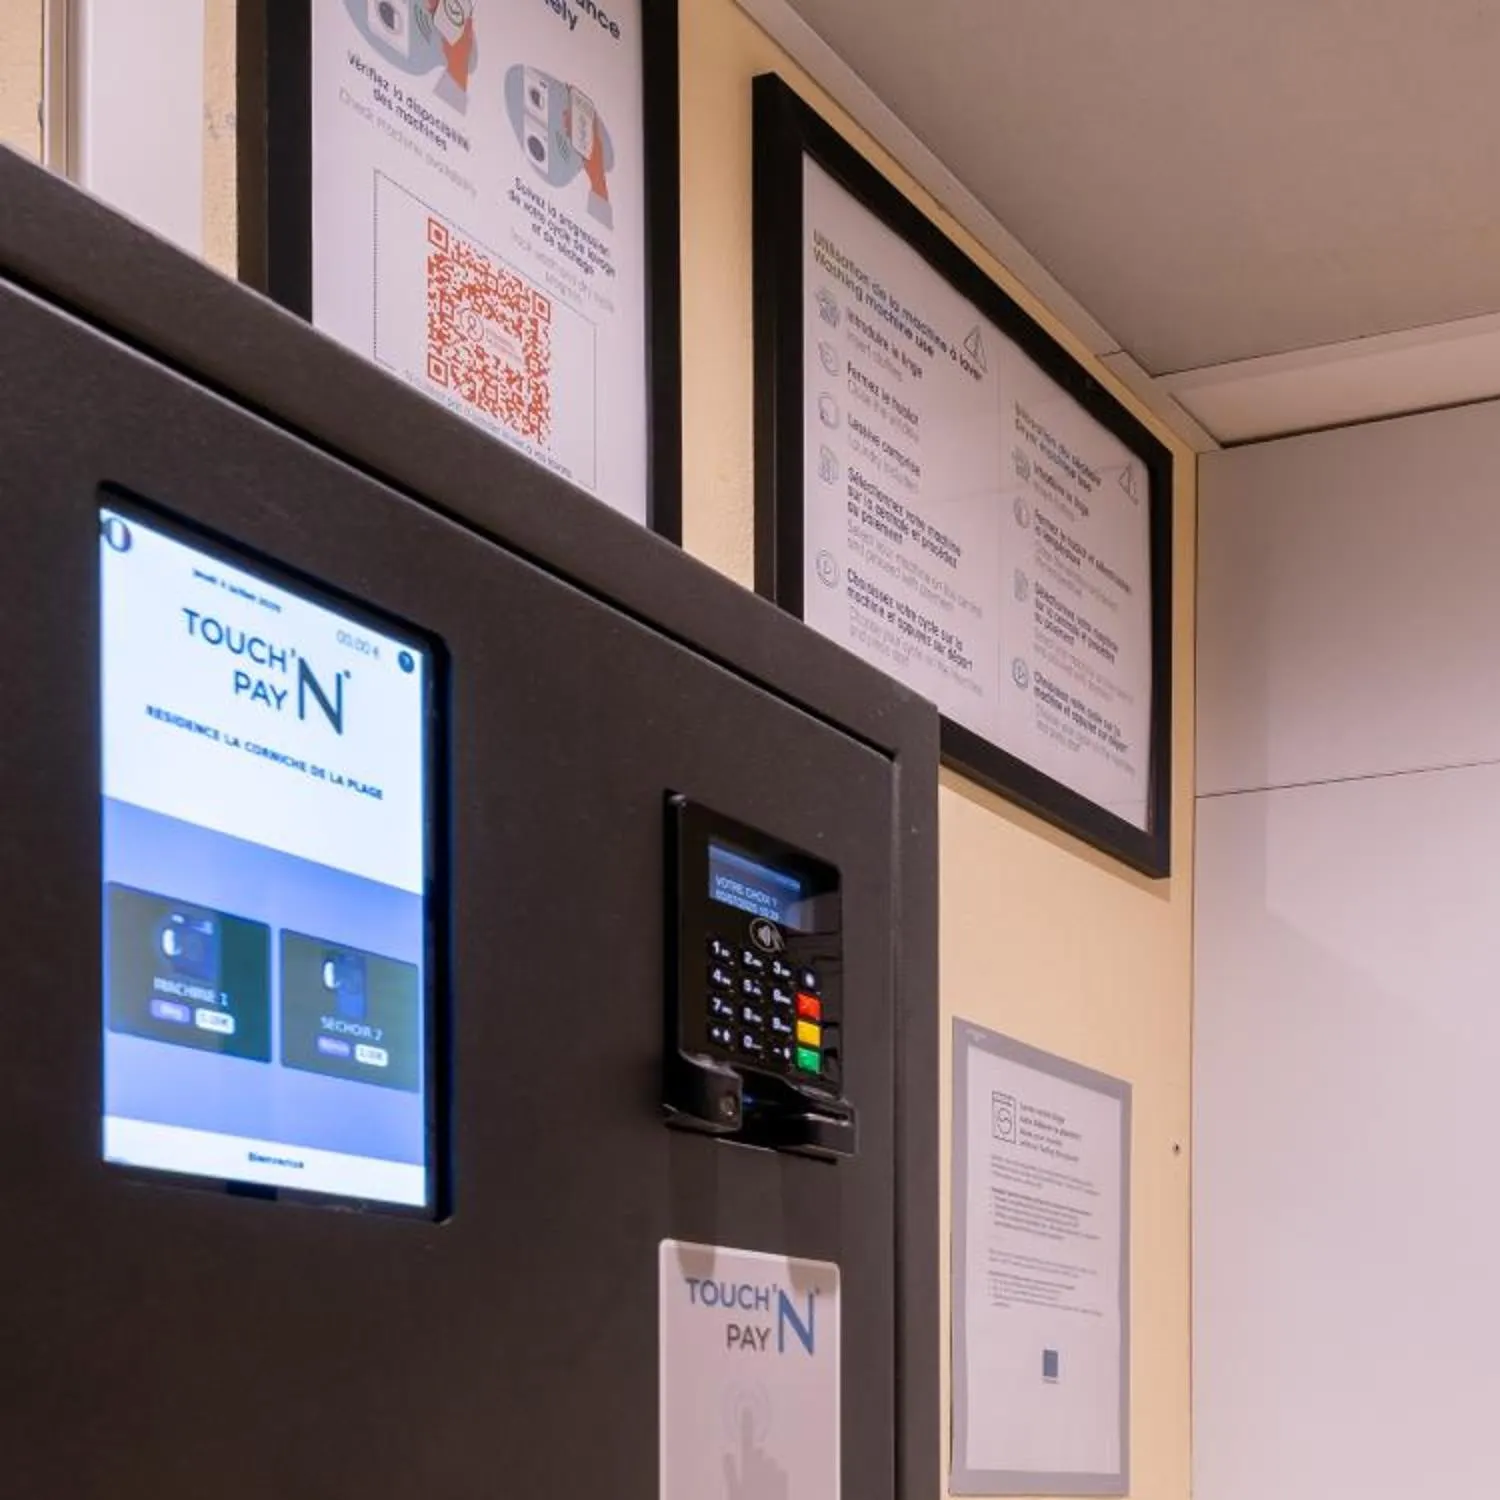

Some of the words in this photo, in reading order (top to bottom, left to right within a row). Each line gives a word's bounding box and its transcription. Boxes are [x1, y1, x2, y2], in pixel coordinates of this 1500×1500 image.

[395, 100, 447, 153] machines
[813, 246, 862, 303] Washing
[866, 290, 912, 342] machine
[915, 334, 934, 360] use
[234, 670, 288, 711] PAY
[223, 732, 241, 750] LA
[244, 741, 306, 773] CORNICHE
[310, 764, 326, 779] DE
[329, 770, 345, 786] LA
[348, 778, 384, 801] PLAGE
[726, 1323, 772, 1352] PAY
